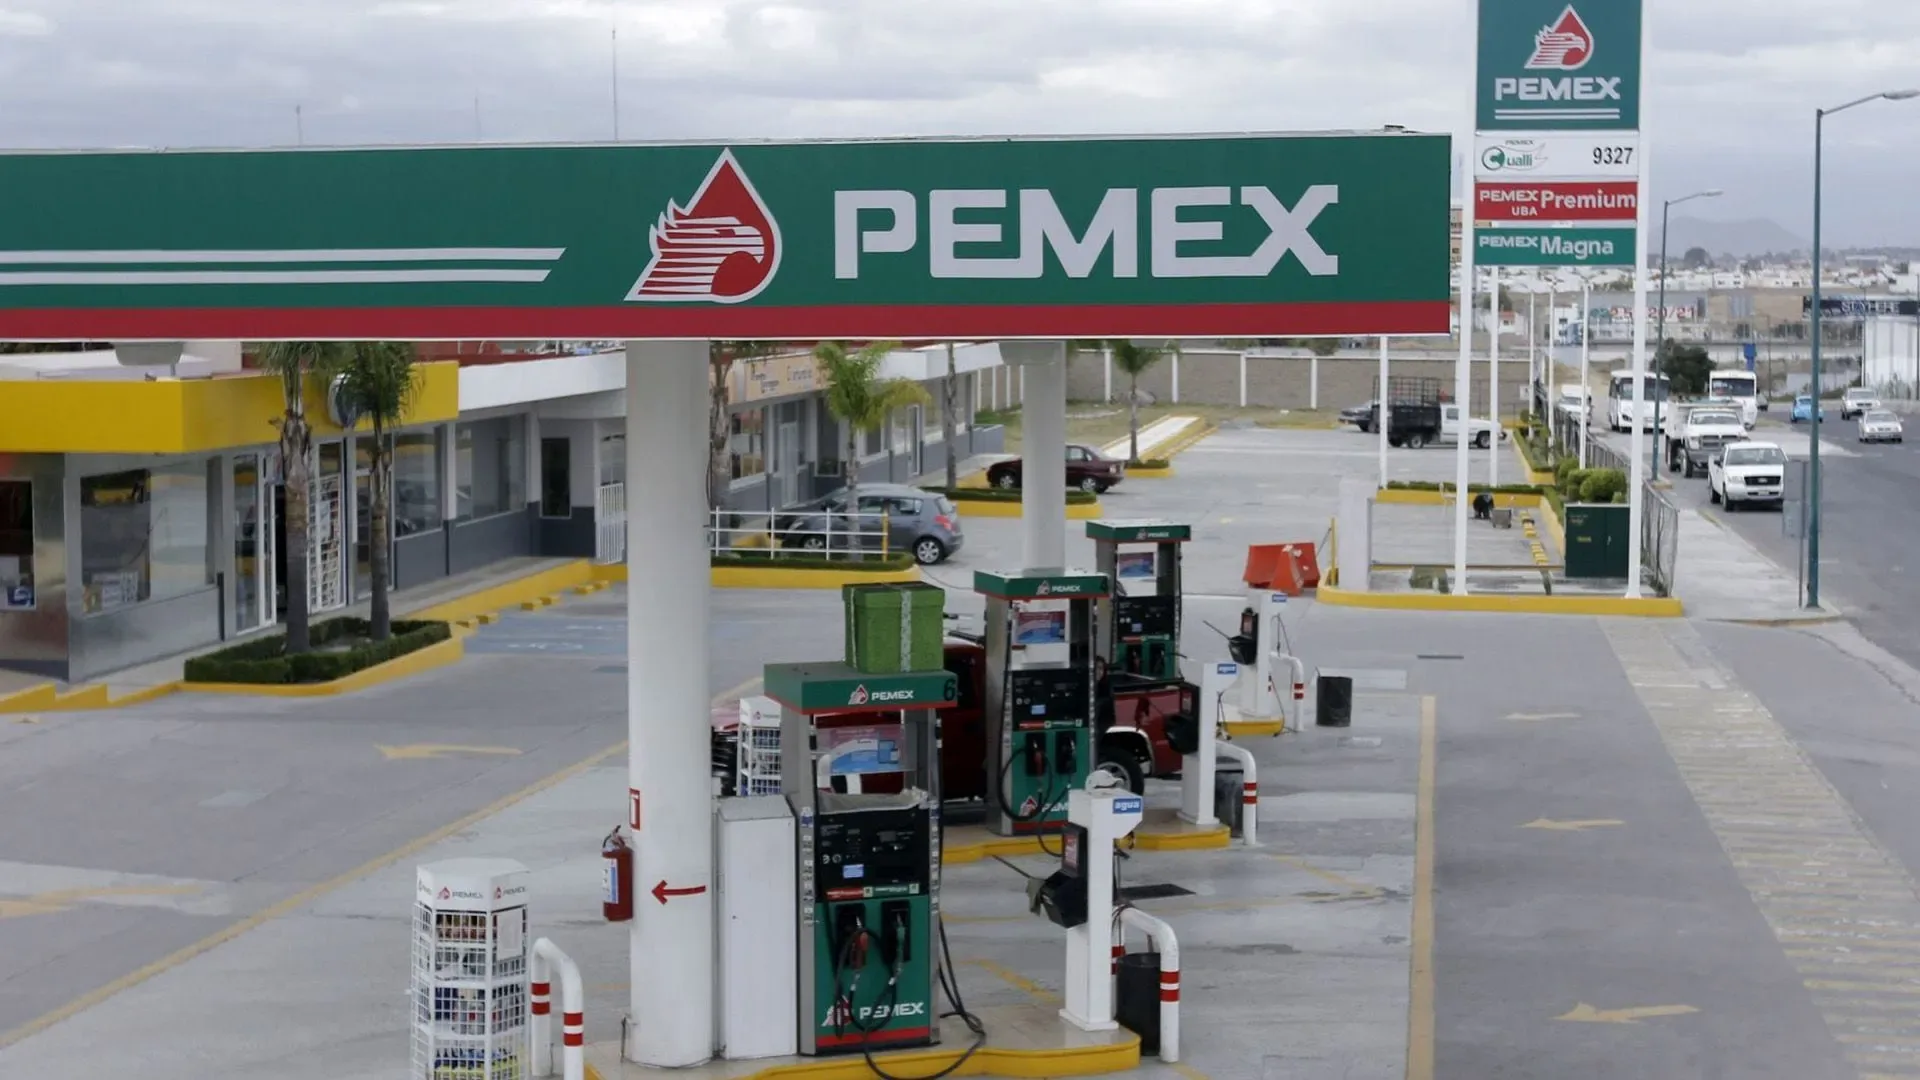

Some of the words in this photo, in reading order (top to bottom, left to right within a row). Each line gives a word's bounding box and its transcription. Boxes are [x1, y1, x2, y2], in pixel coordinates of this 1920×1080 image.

[1494, 76, 1621, 101] PEMEX
[1592, 147, 1633, 165] 9327
[1479, 189, 1538, 203] PEMEX
[1541, 188, 1636, 209] Premium
[1511, 206, 1538, 216] UBA
[835, 184, 1339, 280] PEMEX
[1479, 235, 1538, 248] PEMEX
[1540, 235, 1614, 259] Magna
[871, 689, 914, 701] PEMEX
[943, 679, 956, 702] 6
[1114, 800, 1141, 811] agua
[859, 1002, 925, 1020] PEMEX
